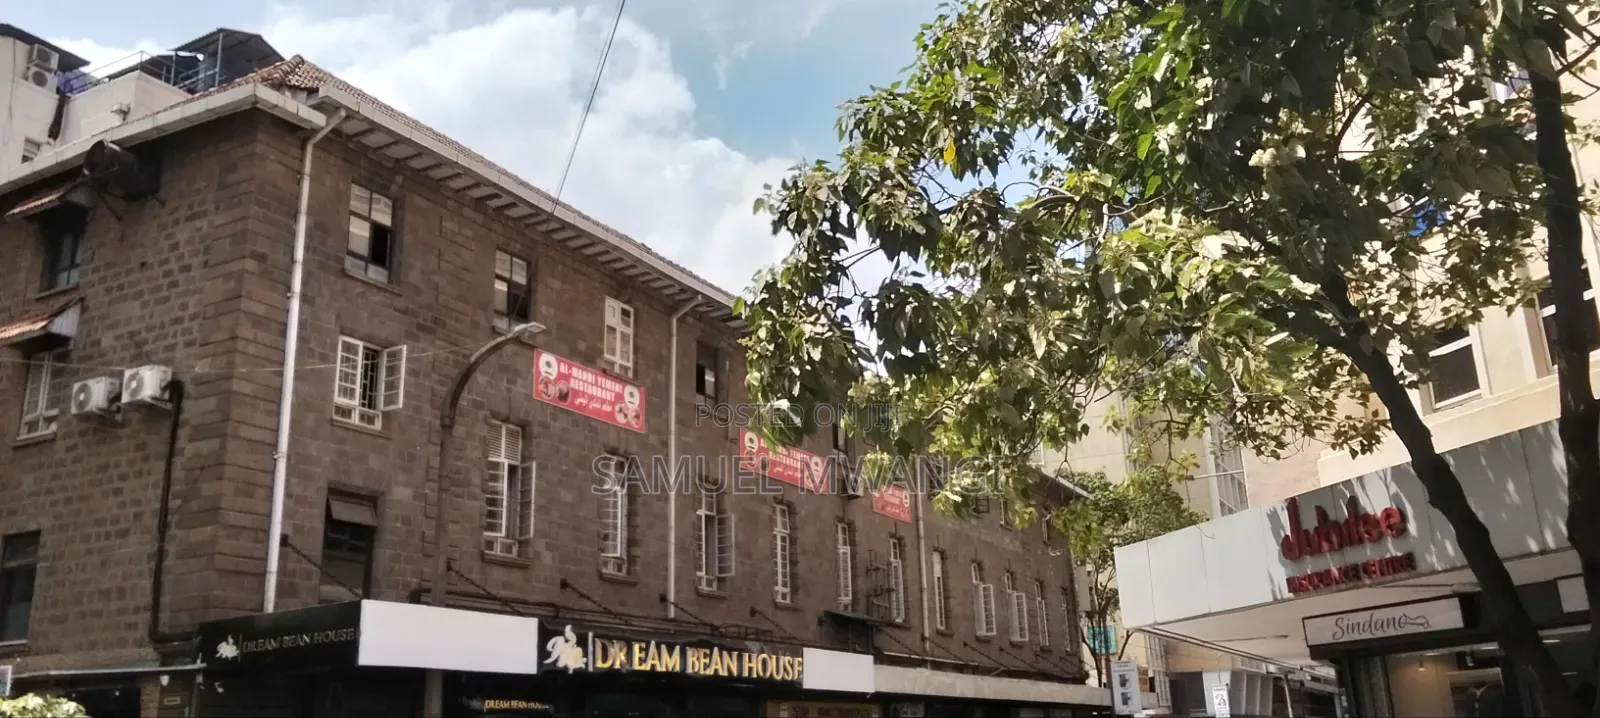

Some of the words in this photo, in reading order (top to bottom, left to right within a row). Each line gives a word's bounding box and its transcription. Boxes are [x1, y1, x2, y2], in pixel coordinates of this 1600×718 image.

[1281, 496, 1407, 561] Jubilee
[243, 637, 280, 653] DREAM
[282, 633, 311, 648] BEAN
[313, 628, 355, 645] HOUSE
[1332, 612, 1411, 641] Sindano
[686, 645, 738, 678] BEAN
[742, 651, 803, 681] HOUSE
[485, 699, 510, 709] DREAM
[511, 699, 527, 709] BEAN
